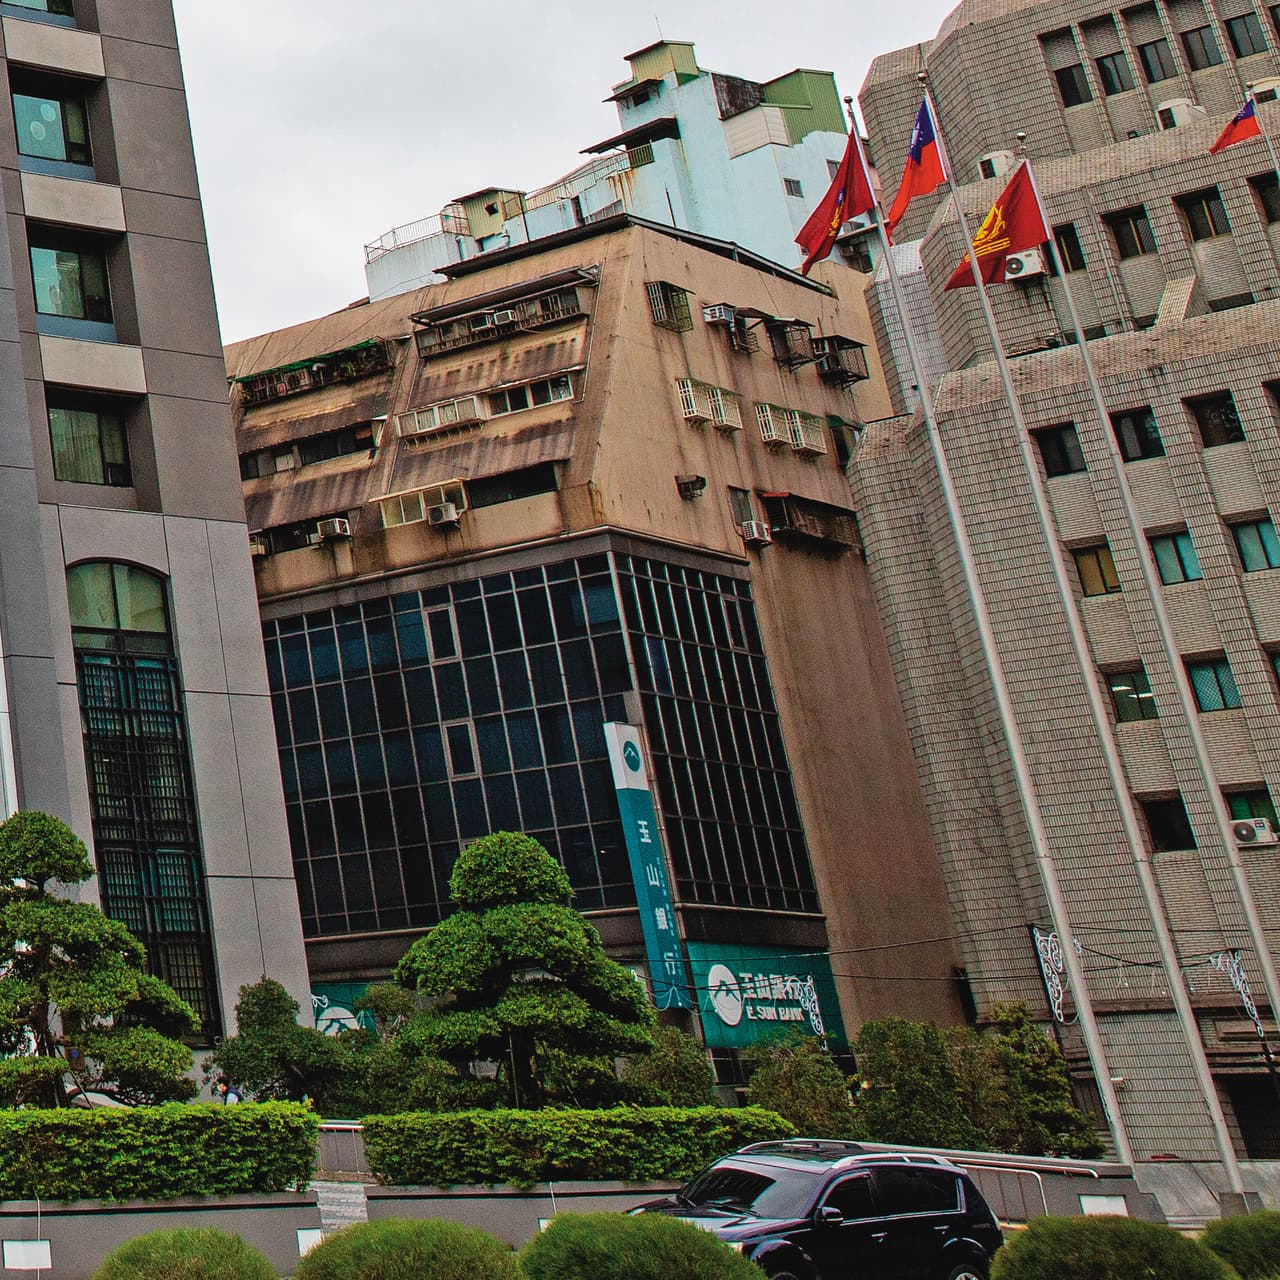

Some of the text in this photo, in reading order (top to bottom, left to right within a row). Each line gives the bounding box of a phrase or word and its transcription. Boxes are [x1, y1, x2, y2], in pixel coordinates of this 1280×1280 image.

[638, 820, 676, 975] 玉山銀行
[779, 1007, 805, 1022] BANK
